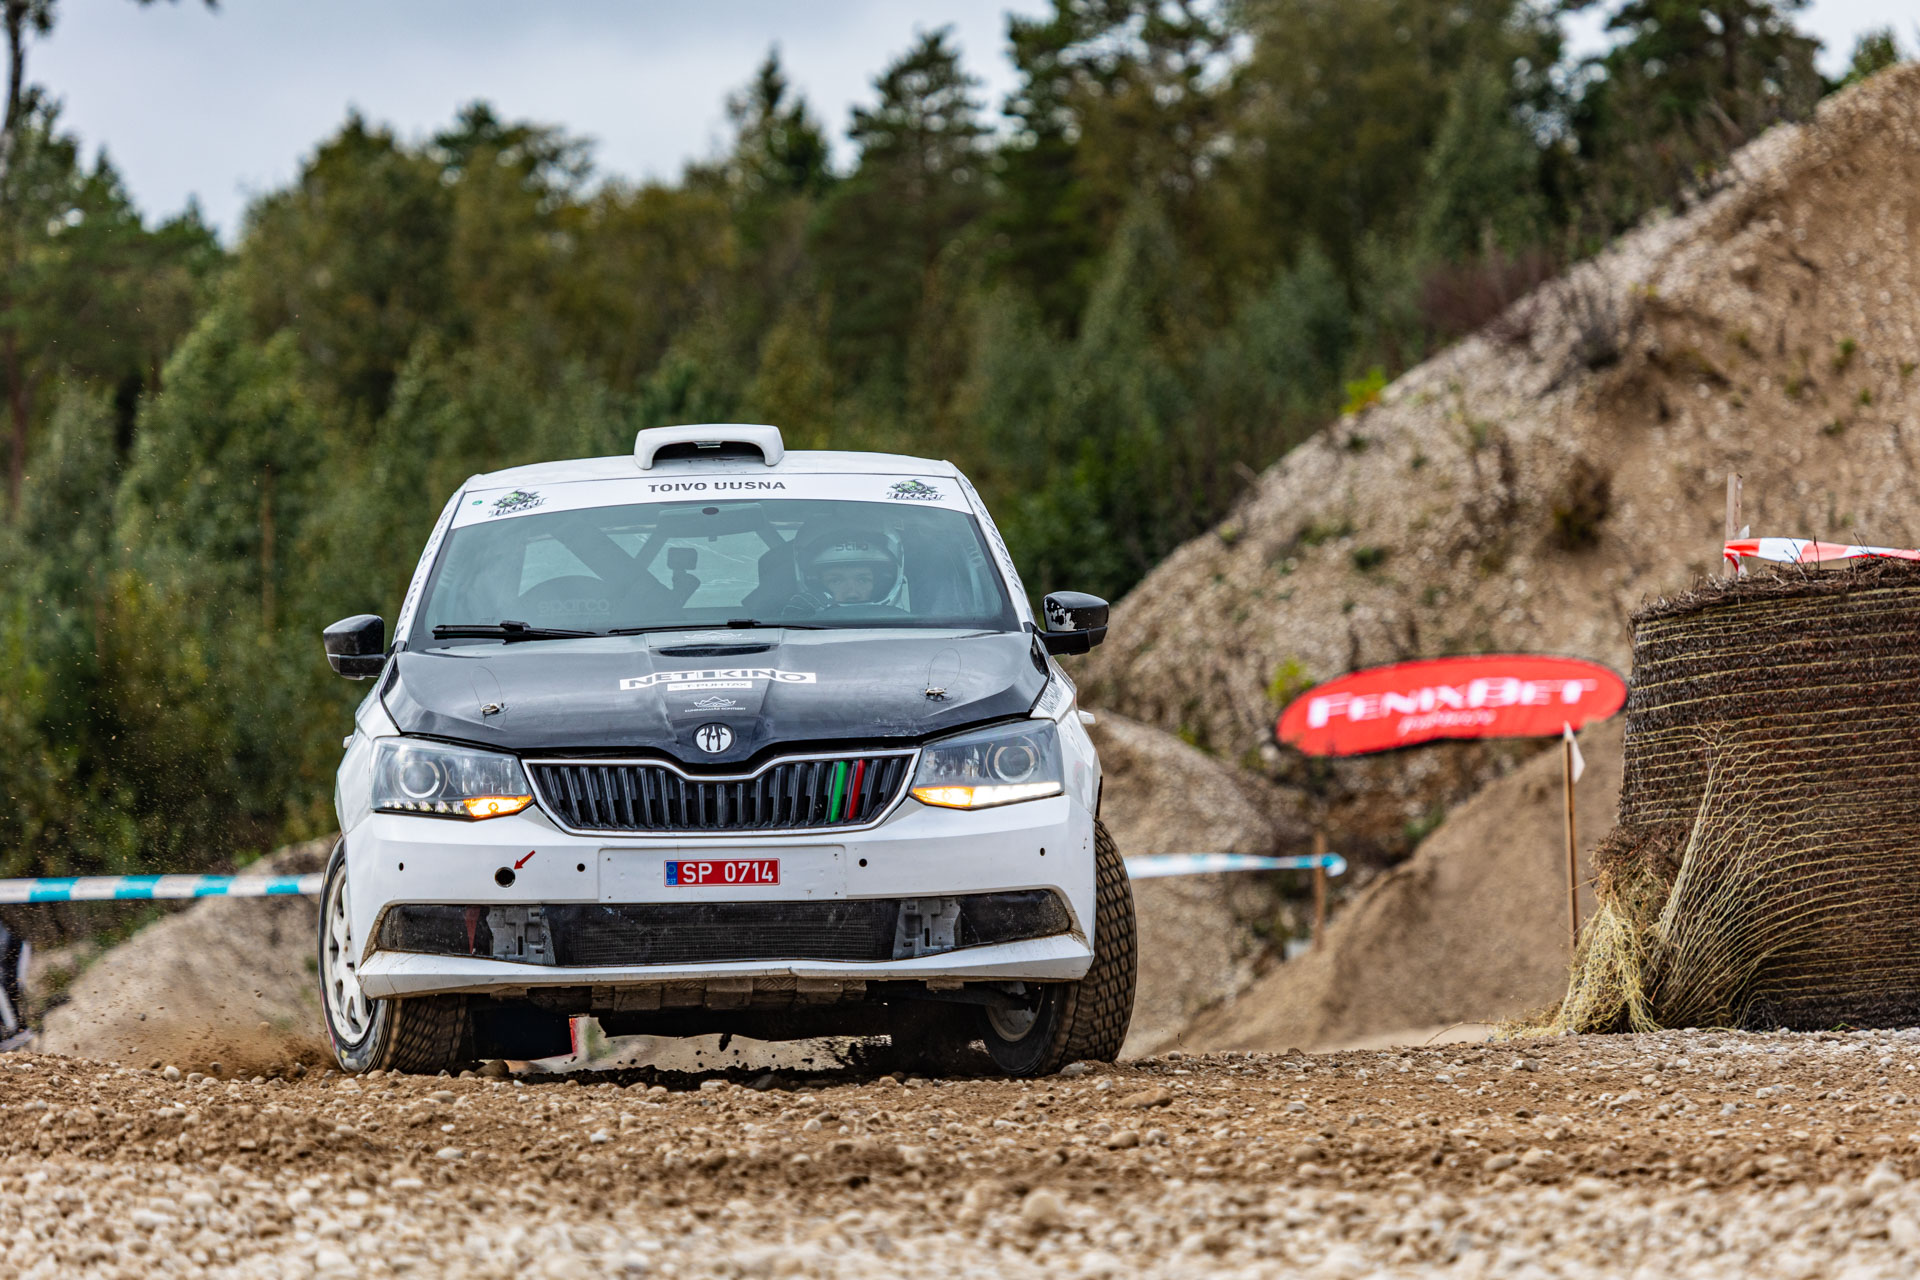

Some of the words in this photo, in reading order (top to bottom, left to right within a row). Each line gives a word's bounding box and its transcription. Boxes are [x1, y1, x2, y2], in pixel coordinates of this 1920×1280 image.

[647, 482, 708, 493] TOIVO
[714, 481, 787, 490] UUSNA
[682, 863, 713, 883] SP
[724, 862, 774, 882] 0714
